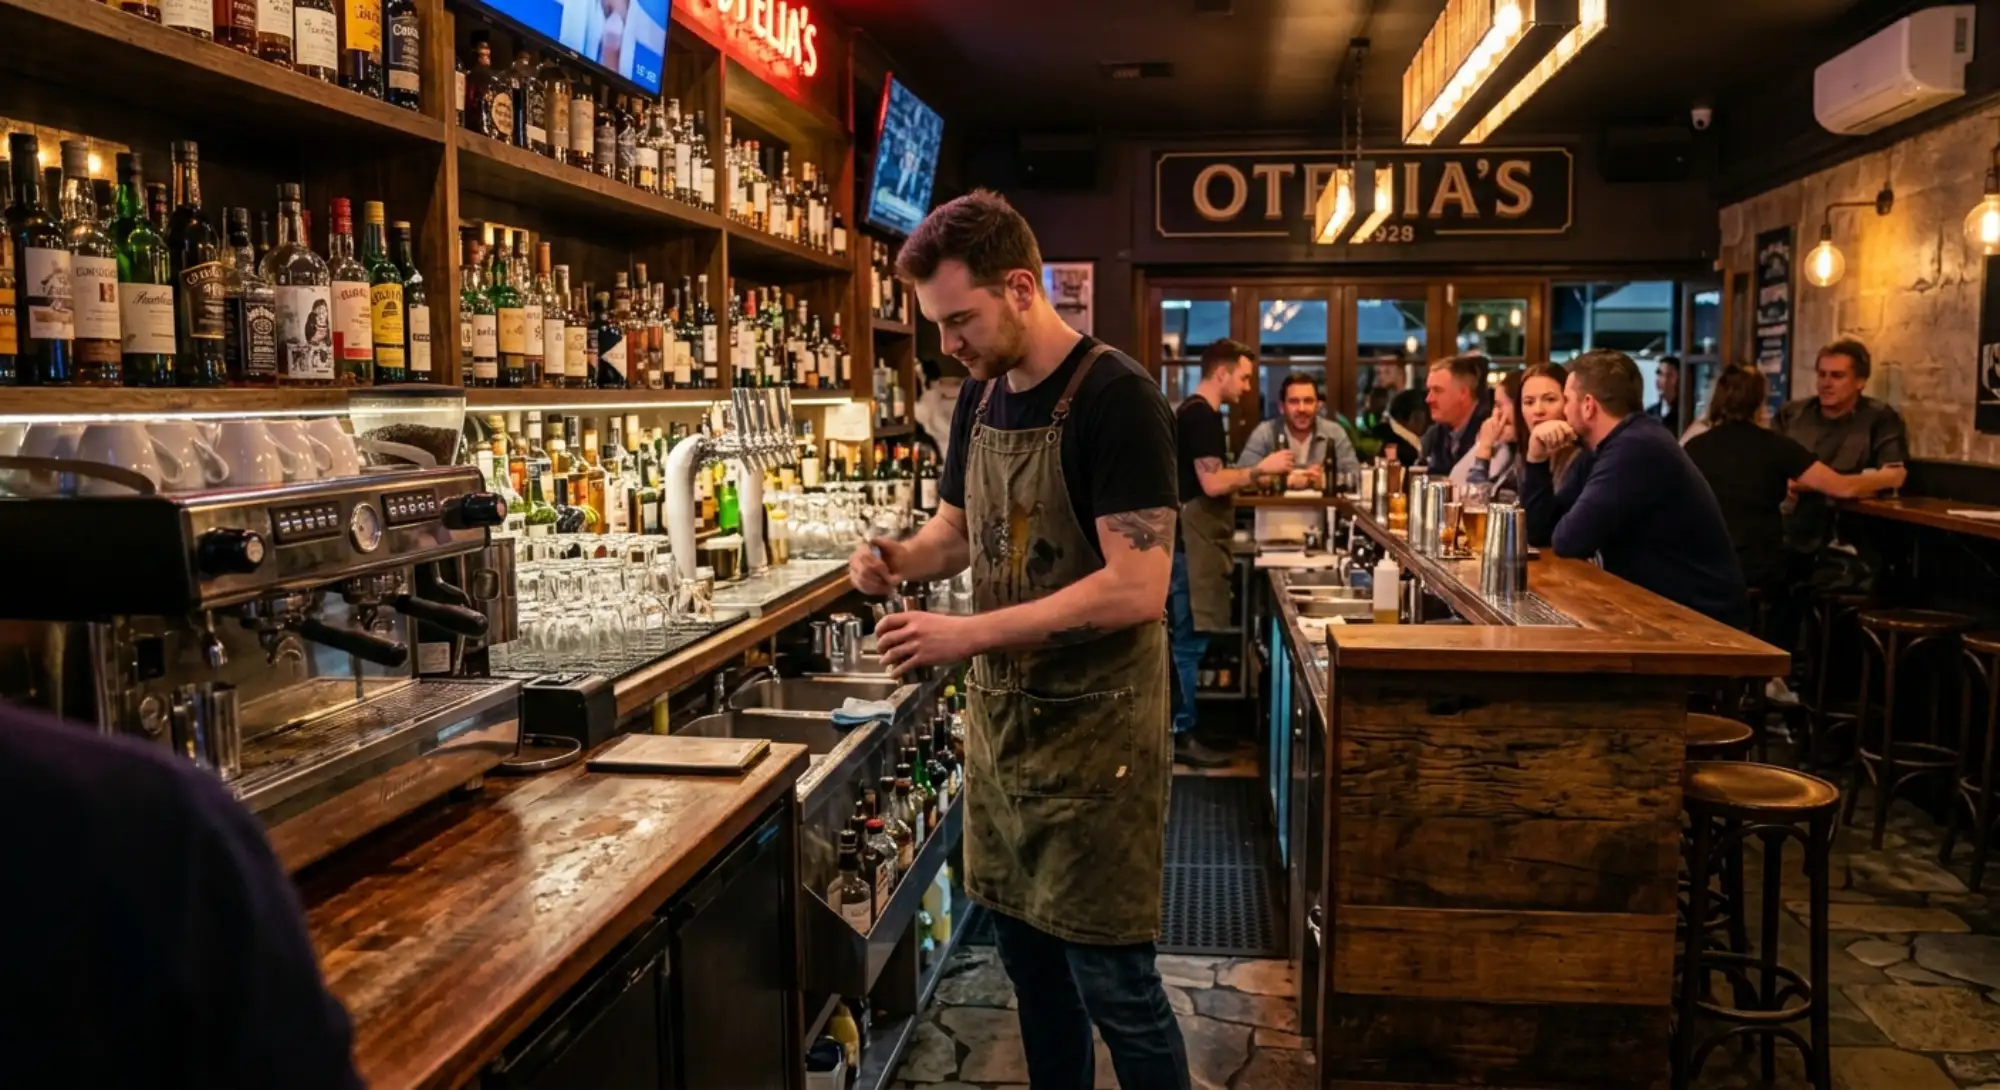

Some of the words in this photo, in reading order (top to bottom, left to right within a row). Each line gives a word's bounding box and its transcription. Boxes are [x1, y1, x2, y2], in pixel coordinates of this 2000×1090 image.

[717, 0, 817, 77] ELIA'S
[1193, 160, 1533, 220] OTEIA'S
[1365, 225, 1415, 243] 928
